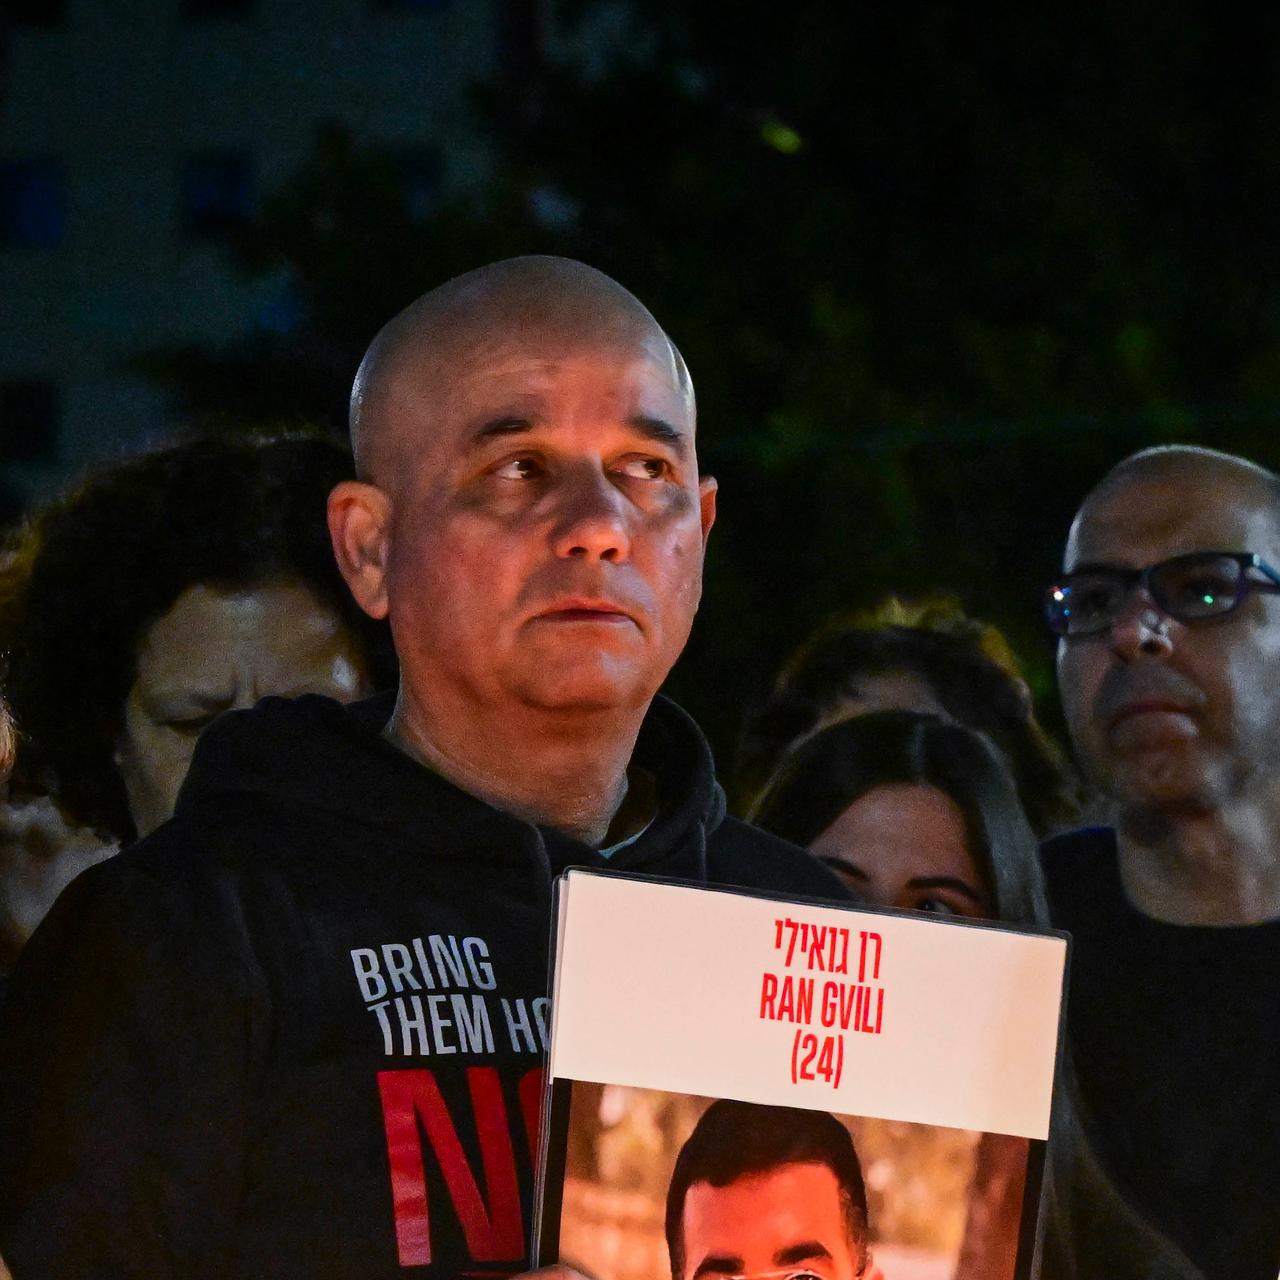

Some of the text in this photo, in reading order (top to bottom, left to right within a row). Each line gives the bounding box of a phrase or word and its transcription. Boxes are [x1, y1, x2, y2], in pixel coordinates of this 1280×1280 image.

[350, 934, 497, 1002] BRING
[774, 917, 882, 983] רן גואילי
[367, 994, 552, 1056] THEM HO
[759, 972, 885, 1035] RAN GVILI
[791, 1029, 844, 1090] (24)
